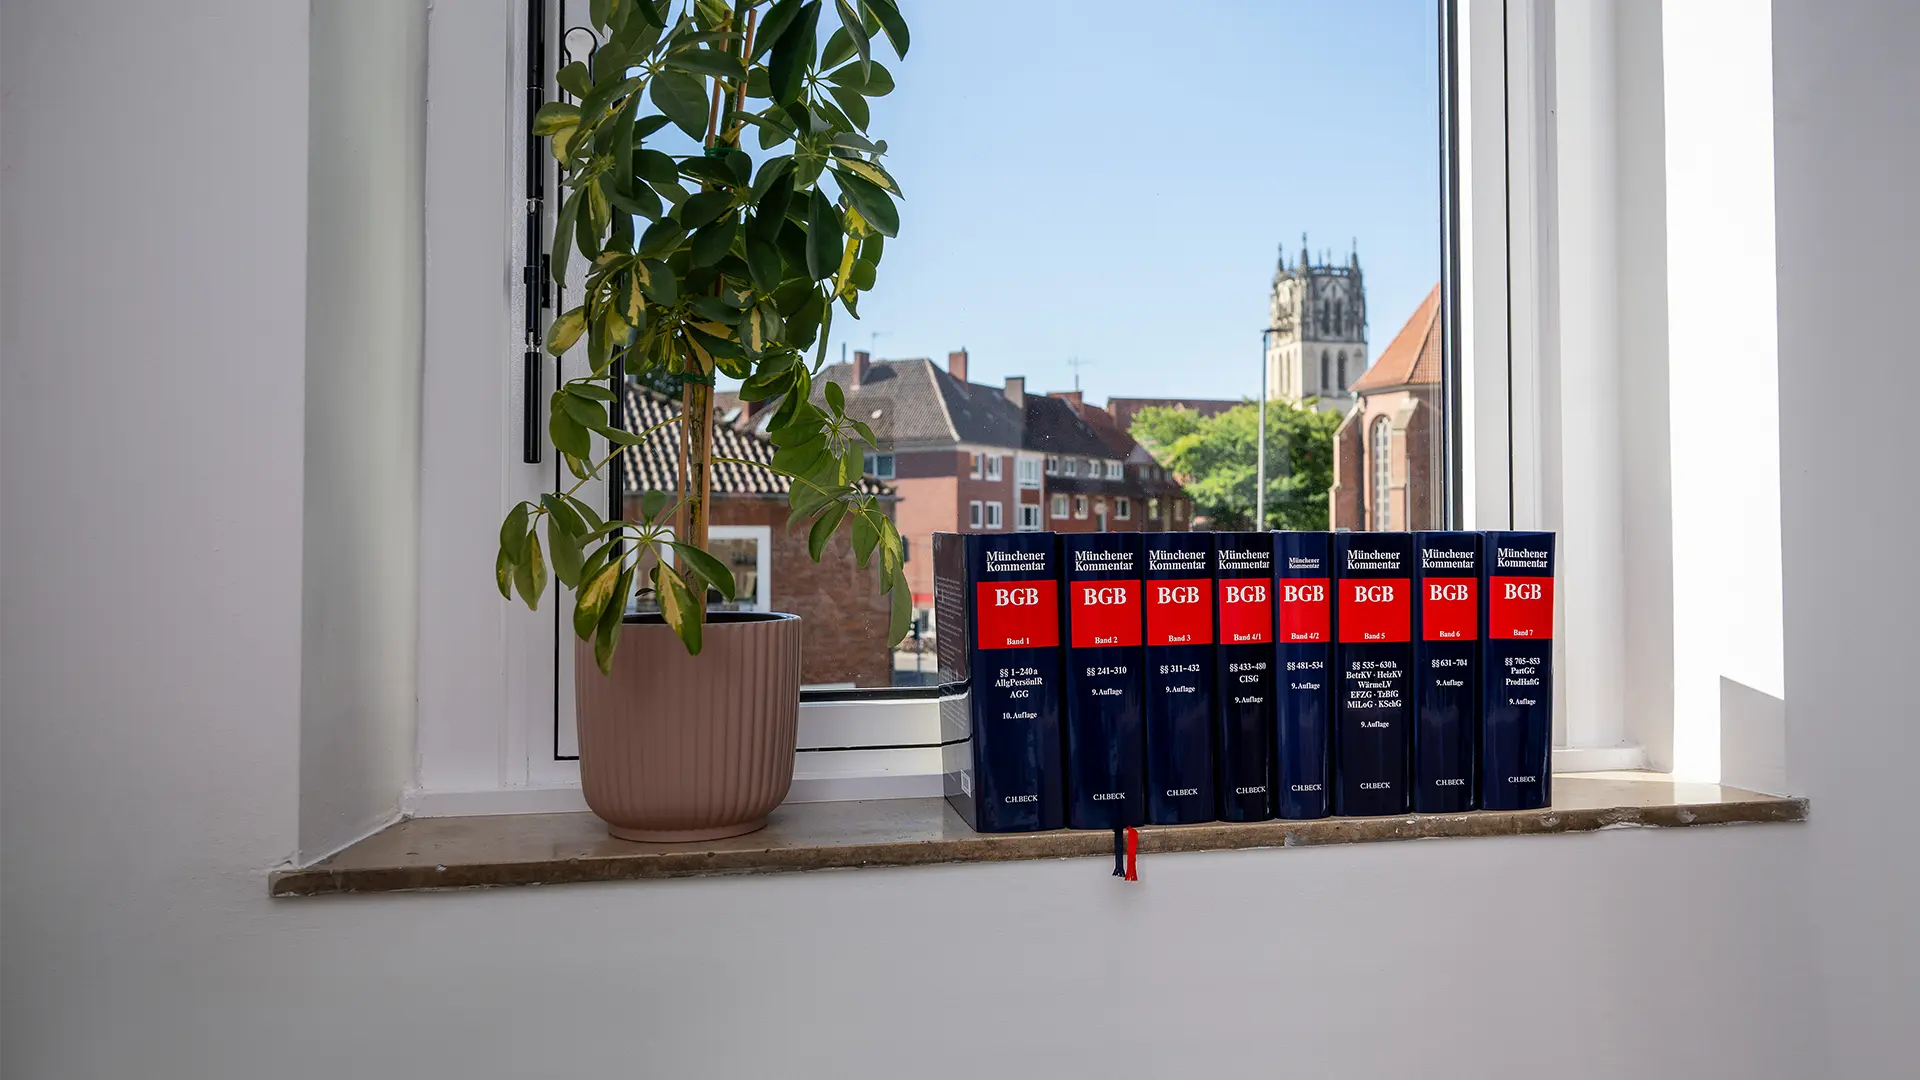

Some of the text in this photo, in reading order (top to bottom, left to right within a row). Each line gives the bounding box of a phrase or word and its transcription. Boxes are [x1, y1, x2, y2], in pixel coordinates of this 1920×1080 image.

[986, 551, 1045, 561] Münchener
[1075, 550, 1133, 560] Münchener
[1149, 550, 1205, 560] Münchener
[1218, 550, 1269, 560] Münchener
[1347, 549, 1400, 560] Münchener
[1422, 549, 1474, 558] Münchener
[1497, 548, 1547, 558] Münchener
[987, 562, 1045, 572] Kommentar
[1075, 561, 1133, 571] Kommentar
[1149, 560, 1206, 570] Kommentar
[1218, 560, 1270, 569] Kommentar
[1347, 559, 1400, 570] Kommentar
[1422, 559, 1474, 568] Kommentar
[1497, 558, 1547, 568] Kommentar
[995, 588, 1039, 606] BGB
[1084, 588, 1126, 606] BGB
[1158, 586, 1199, 604] BGB
[1226, 586, 1266, 603] BGB
[1284, 585, 1324, 602] BGB
[1355, 586, 1394, 603] BGB
[1430, 584, 1468, 601] BGB
[1504, 584, 1541, 600] BGB
[1287, 662, 1295, 670] §§
[1352, 662, 1360, 670] §§
[1432, 660, 1439, 668] §§
[1505, 658, 1513, 666] §§
[1000, 669, 1009, 677] §§
[1086, 668, 1096, 676] §§
[1160, 666, 1168, 674] §§
[1229, 664, 1238, 672] §§
[1239, 675, 1258, 683] CISG
[1346, 670, 1402, 679] BetrKV HeizKV
[995, 677, 1042, 688] AllgPersönlR
[1506, 678, 1539, 686] ProdHaftG
[1010, 690, 1029, 698] AGG
[1377, 690, 1399, 698] TzBfG
[1379, 700, 1401, 708] KSchG
